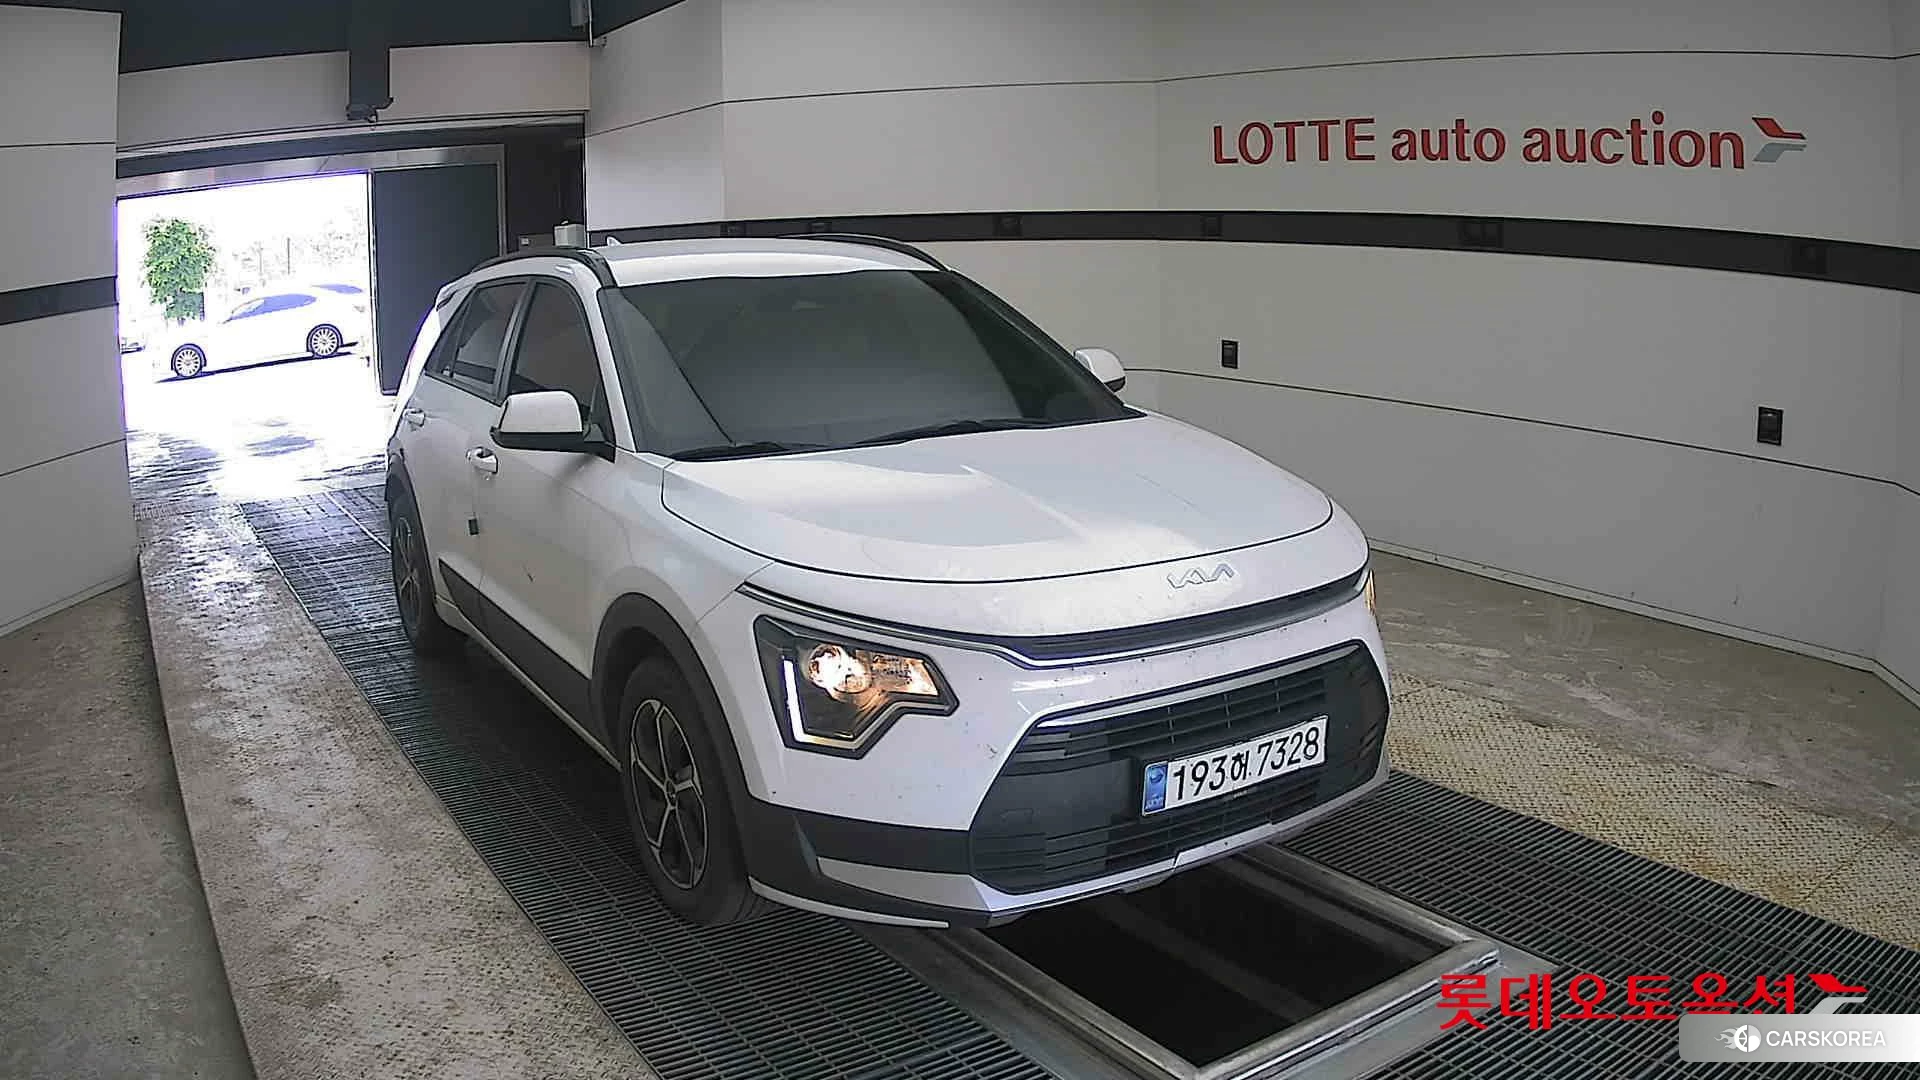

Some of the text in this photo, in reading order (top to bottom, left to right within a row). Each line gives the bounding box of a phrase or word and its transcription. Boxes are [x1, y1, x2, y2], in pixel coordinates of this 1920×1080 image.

[1213, 110, 1745, 169] LOTTE auto auction
[1258, 726, 1320, 776] 7328
